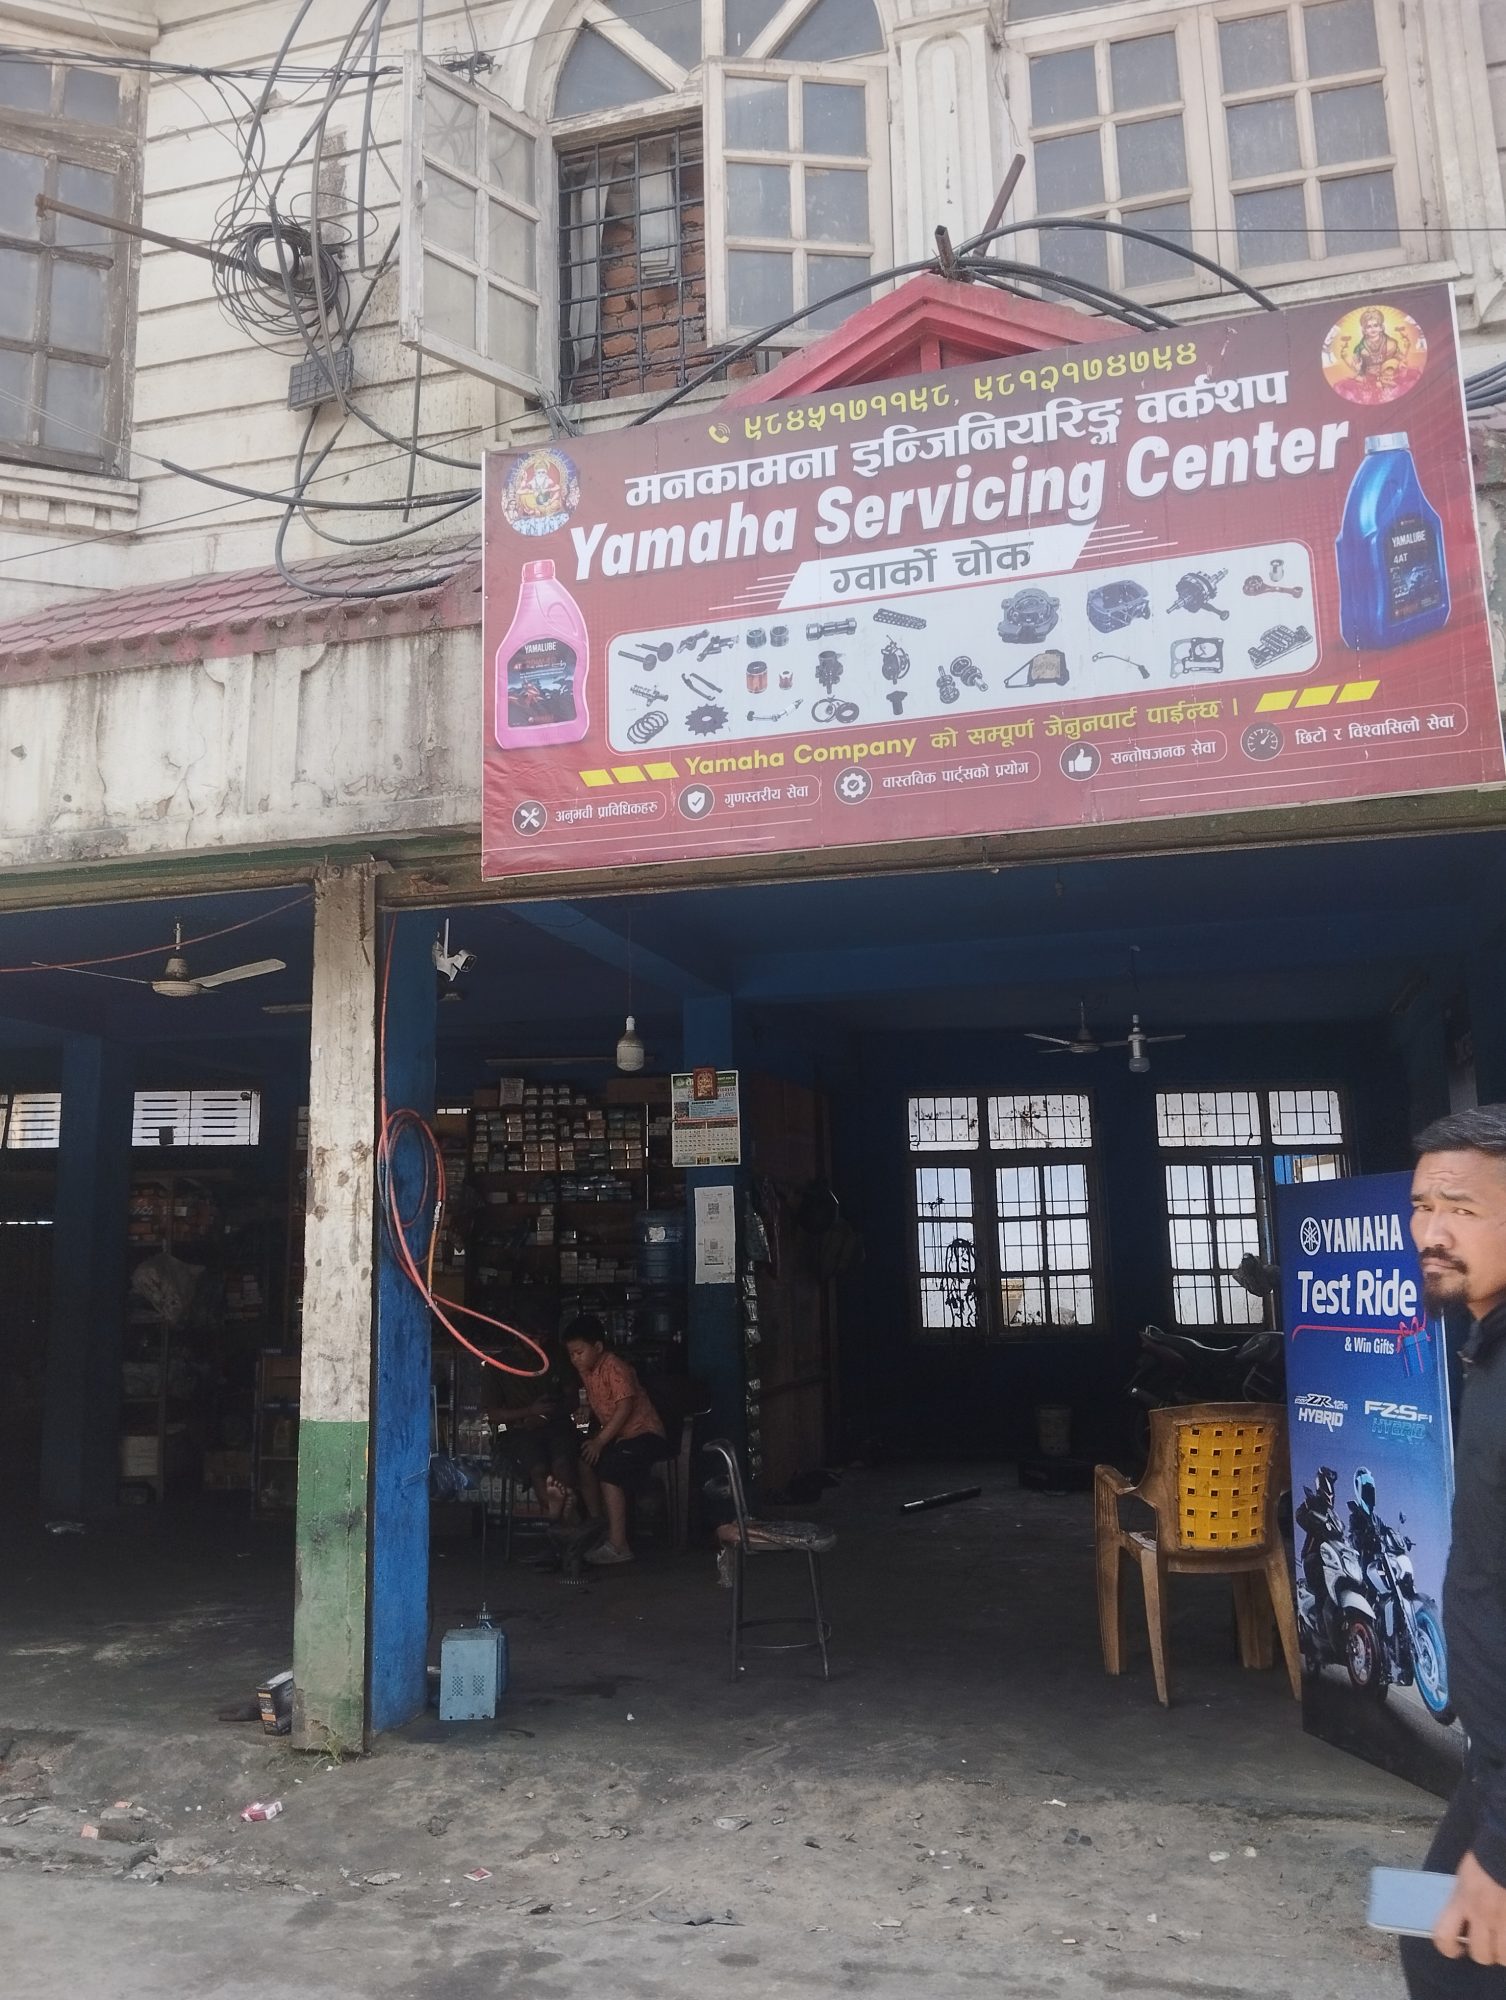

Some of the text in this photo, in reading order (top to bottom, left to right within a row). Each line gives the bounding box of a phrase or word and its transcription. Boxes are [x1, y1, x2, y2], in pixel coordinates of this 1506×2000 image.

[625, 444, 838, 506] मनकामना
[1135, 370, 1289, 424] वर्कशप
[570, 420, 1349, 581] Yamaha Servicing Center
[1392, 530, 1426, 547] YAMALUBE
[830, 540, 1034, 593] ग्वार्को चोक
[524, 641, 557, 654] YAMALUBE
[1296, 713, 1454, 744] छिटो र विश्वासिलो सेवा
[685, 750, 785, 775] Yamaha
[794, 737, 917, 764] Company
[930, 727, 958, 749] को
[965, 718, 1035, 748] सम्पूर्ण
[1110, 739, 1216, 764] सन्तोषजनक सेवा
[882, 770, 936, 788] वास्तविक
[995, 760, 1029, 777] प्रयोग
[724, 784, 808, 808] गुणस्तरीय सेवा
[555, 801, 658, 823] अनुभवी प्राविधिकहरु
[1321, 1214, 1403, 1253] YAMAHA
[1298, 1268, 1417, 1317] Test Ride
[1344, 1337, 1394, 1355] & Win Gifts
[1298, 1407, 1344, 1432] HYBRID
[1371, 1418, 1427, 1440] HYBRID
